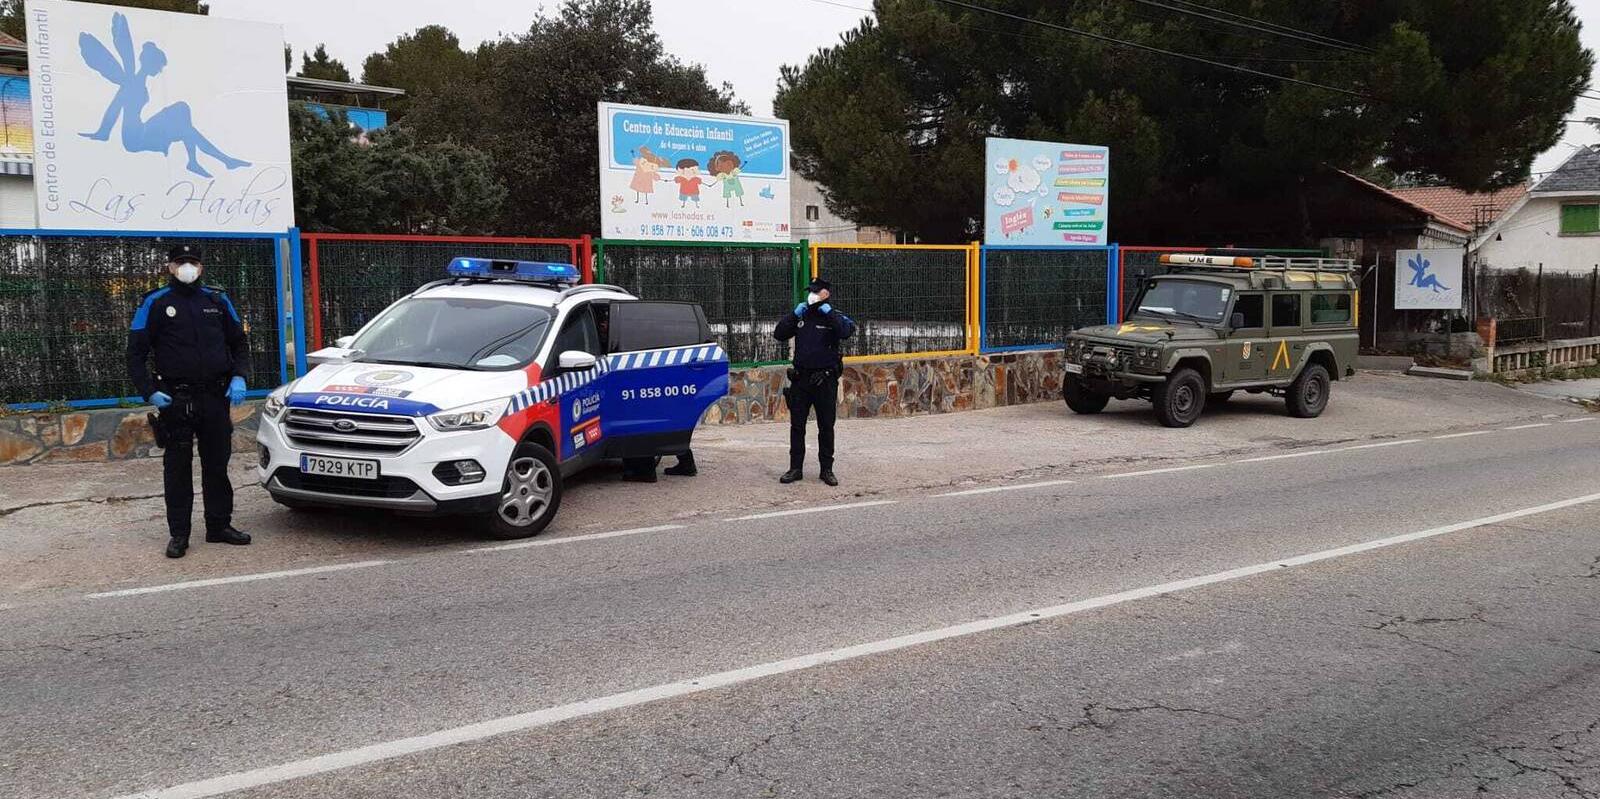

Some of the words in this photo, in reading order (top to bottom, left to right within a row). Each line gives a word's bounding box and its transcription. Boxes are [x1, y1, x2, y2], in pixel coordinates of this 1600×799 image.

[33, 8, 49, 60] Infantil
[38, 64, 56, 137] Educación
[623, 120, 651, 134] Centro
[653, 123, 663, 135] de
[665, 123, 705, 139] Educación
[706, 127, 734, 141] Infantil
[43, 143, 56, 159] de
[46, 164, 59, 212] Centro
[69, 178, 146, 223] Las
[161, 167, 287, 226] Hadas
[640, 224, 649, 235] 91
[666, 225, 675, 236] 77
[721, 226, 733, 238] 473
[622, 389, 635, 400] 91
[640, 387, 661, 398] 858
[664, 386, 679, 396] 00
[682, 384, 697, 395] 06
[315, 395, 389, 410] POLICÍA
[309, 459, 343, 474] 7929
[347, 462, 373, 476] KTP
